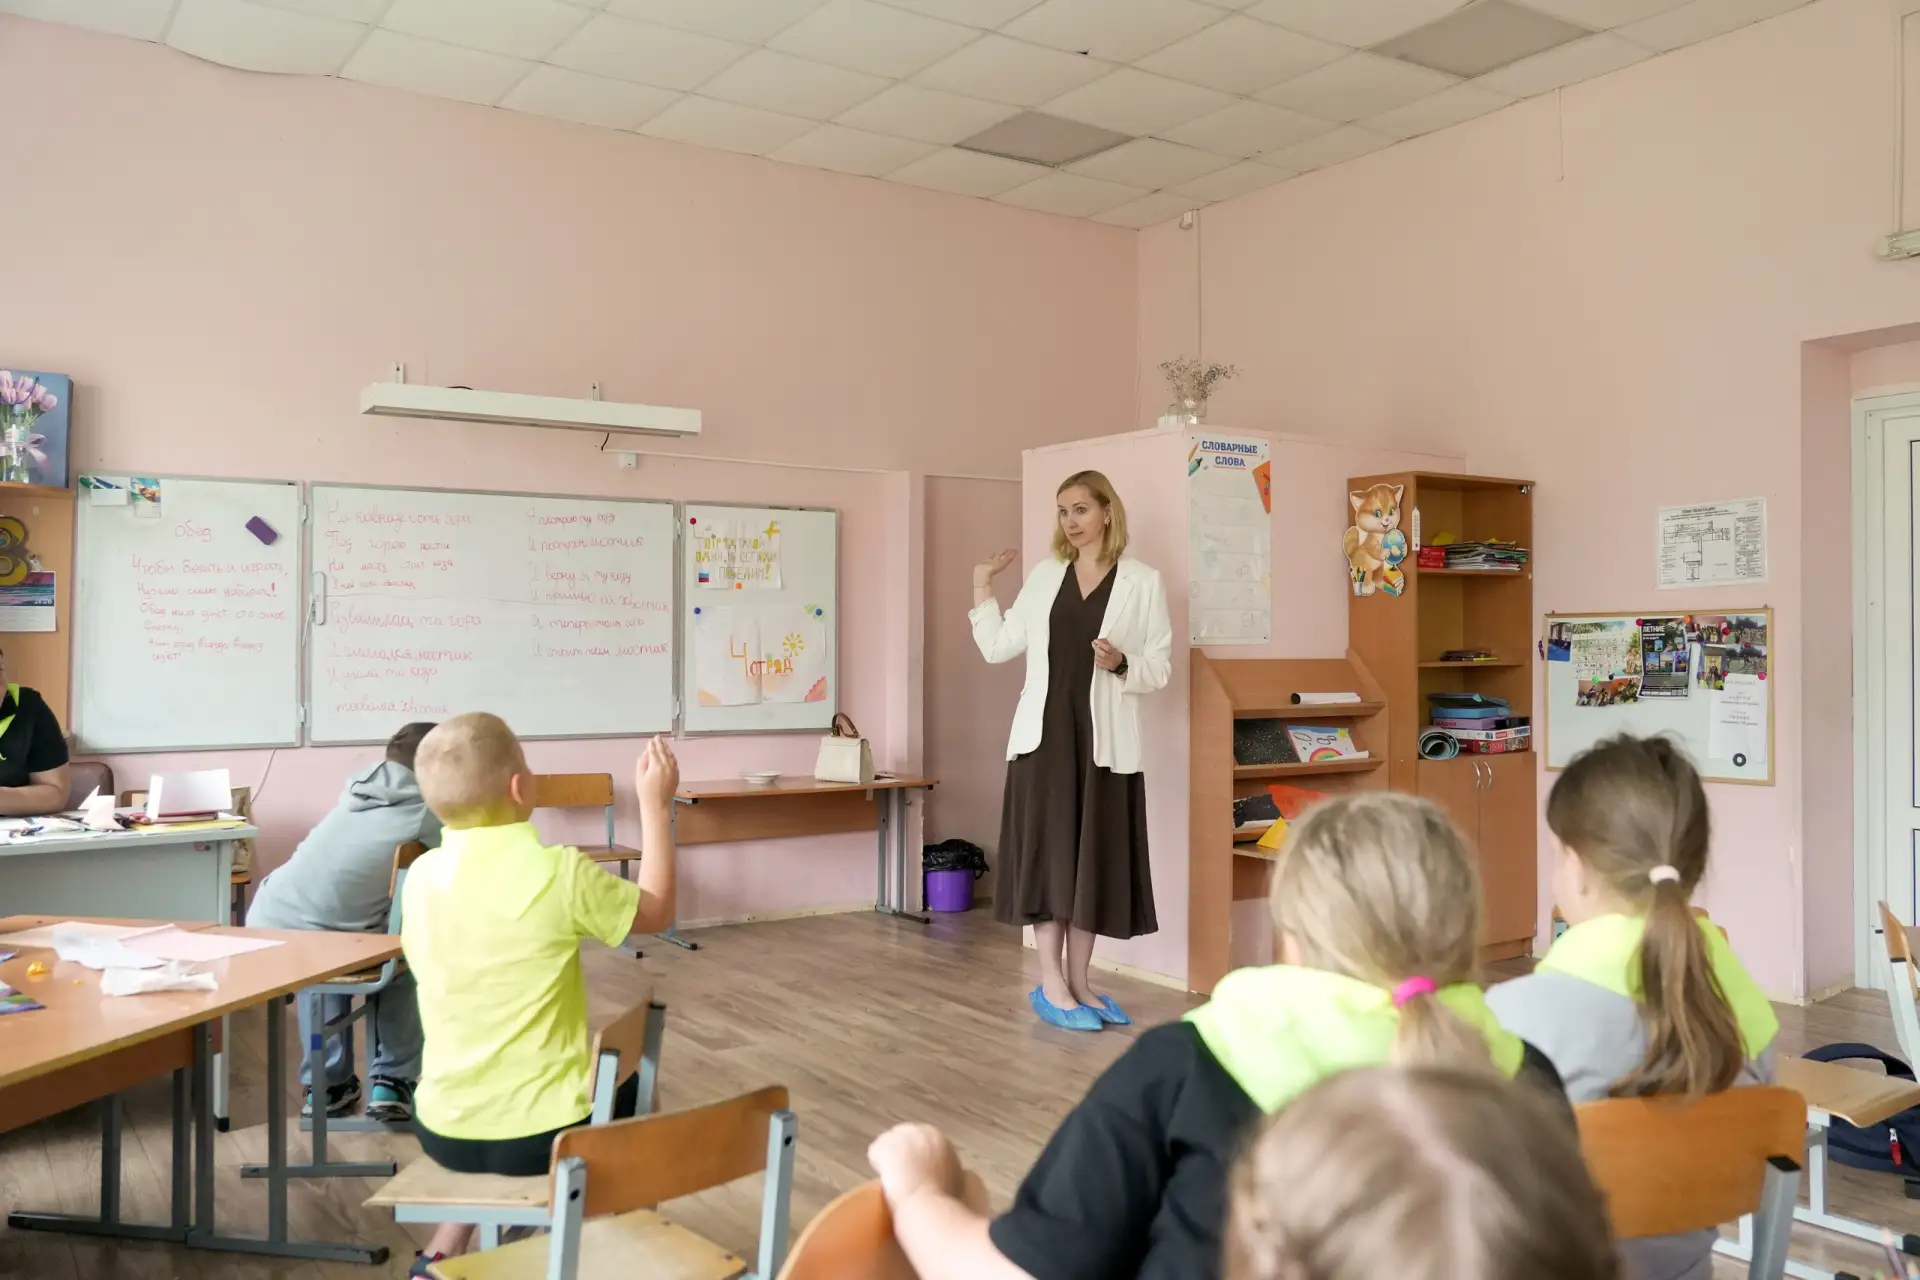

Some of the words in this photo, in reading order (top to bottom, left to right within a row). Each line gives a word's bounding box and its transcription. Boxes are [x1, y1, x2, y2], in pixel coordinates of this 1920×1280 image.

[1201, 440, 1258, 455] СЛОВАРНЫЕ
[1214, 455, 1246, 468] СЛОВА
[174, 519, 212, 542] Обед
